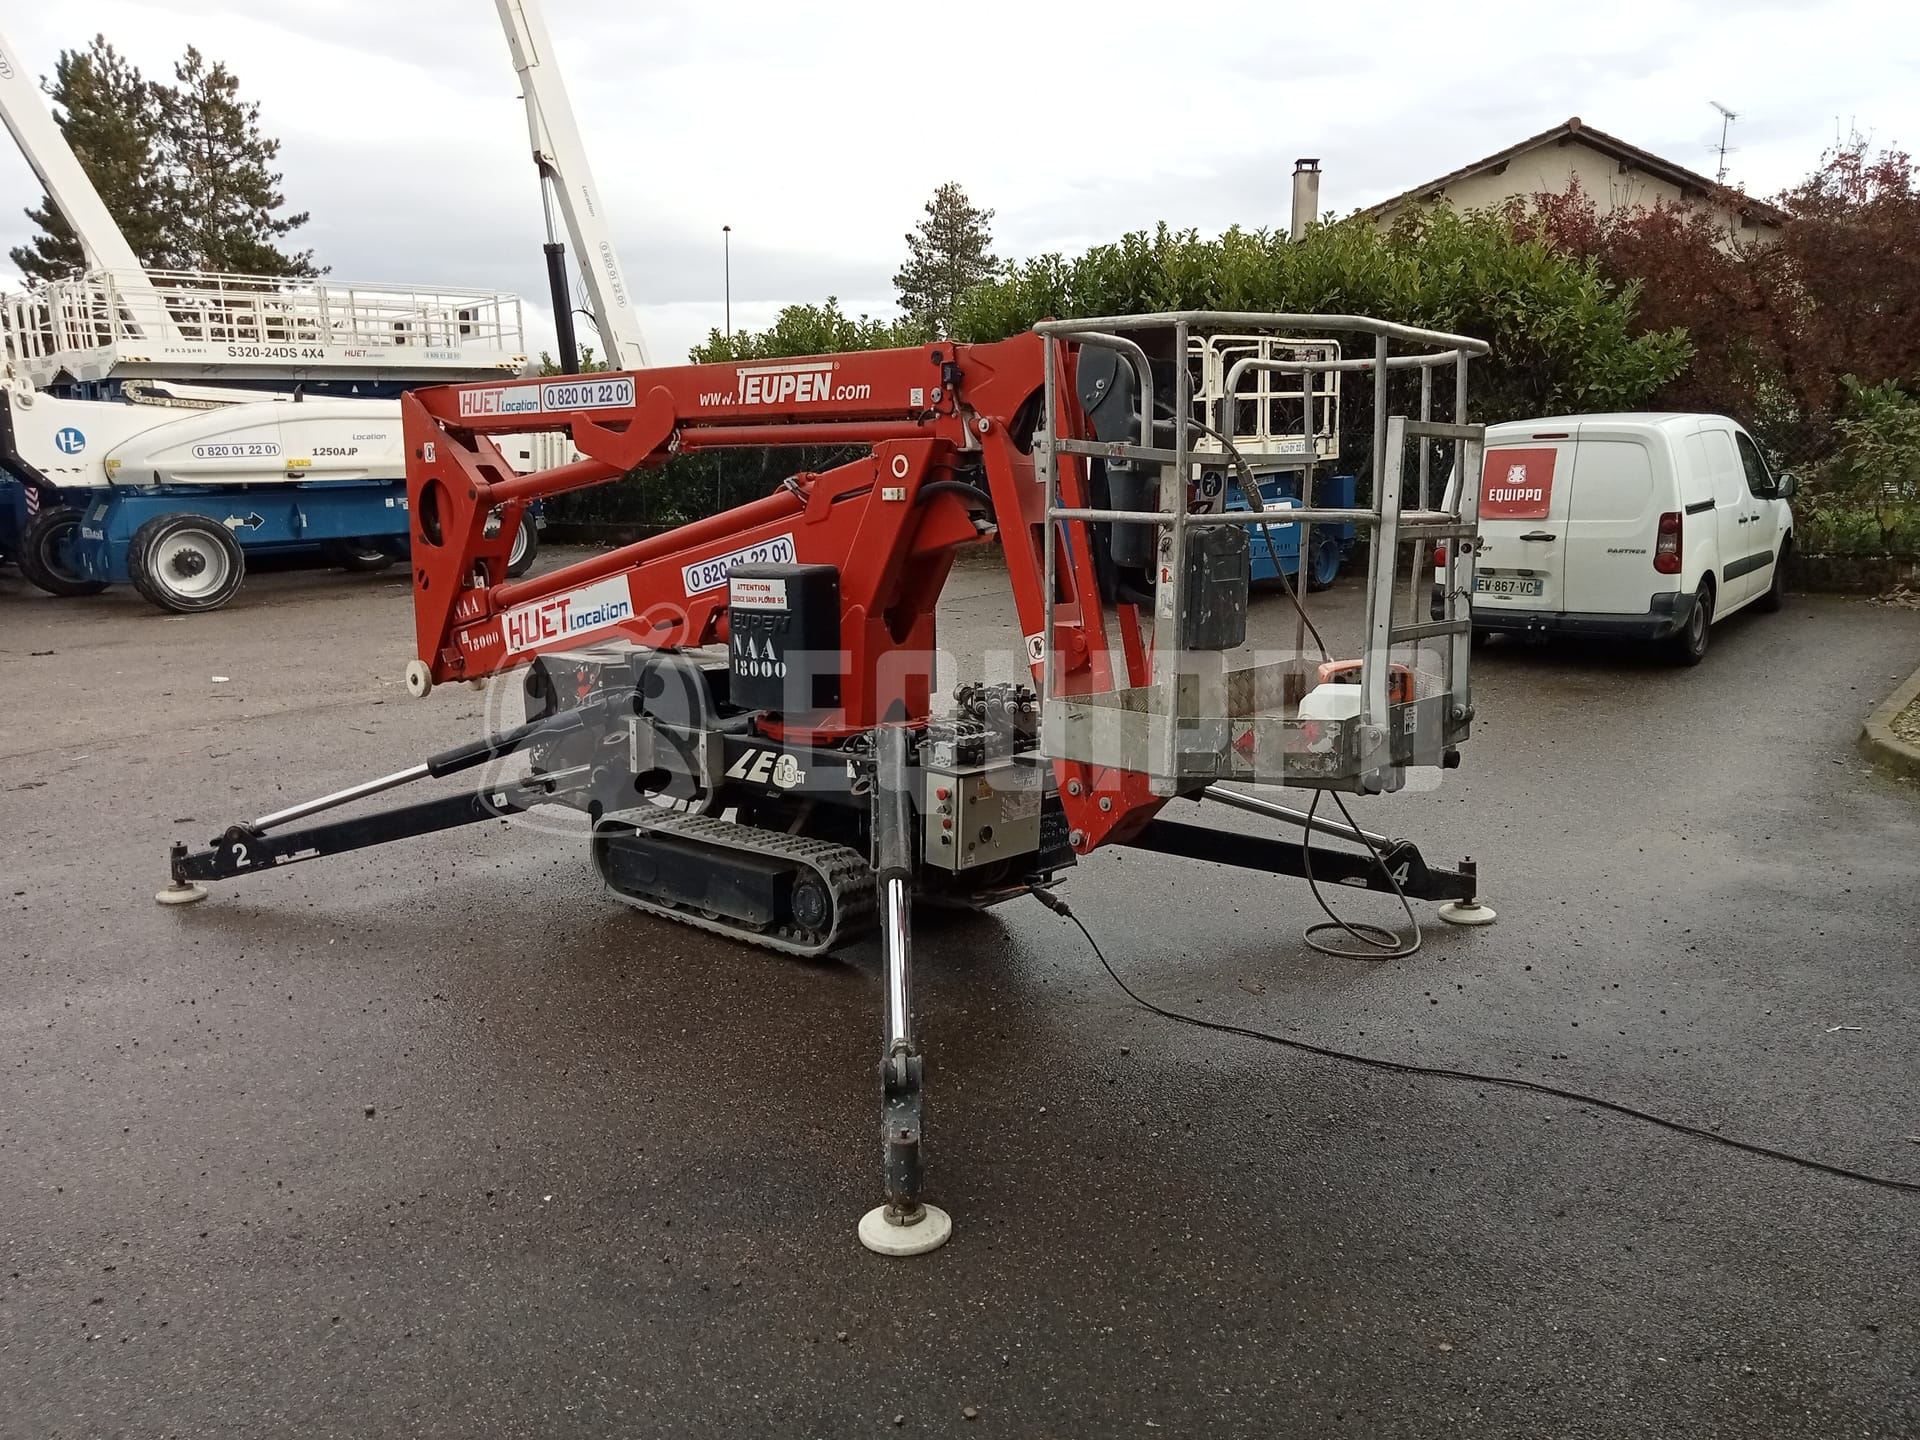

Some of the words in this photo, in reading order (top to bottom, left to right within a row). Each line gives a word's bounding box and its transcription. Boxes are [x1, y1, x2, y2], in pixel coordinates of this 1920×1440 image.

[228, 346, 298, 358] S320-24DS
[301, 348, 325, 359] 4X4
[344, 350, 367, 358] HUET
[462, 390, 504, 414] HUET
[502, 400, 539, 412] Location
[547, 389, 555, 406] 0
[558, 388, 578, 405] 820
[581, 386, 594, 403] 01
[599, 384, 613, 402] 22
[617, 383, 629, 401] 01
[352, 433, 387, 441] Location
[197, 448, 204, 457] 0
[208, 447, 229, 456] 820
[232, 446, 244, 455] 01
[248, 446, 262, 455] 22
[265, 445, 277, 454] 01
[312, 447, 359, 456] 1250AJP
[691, 570, 700, 588] 0
[703, 561, 727, 584] 820
[772, 542, 788, 562] 01
[508, 598, 571, 649] HUET
[570, 601, 628, 631] Location
[733, 633, 777, 660] NAA
[735, 658, 787, 679] 18000
[232, 843, 251, 868] 2
[1392, 861, 1410, 885] 4
